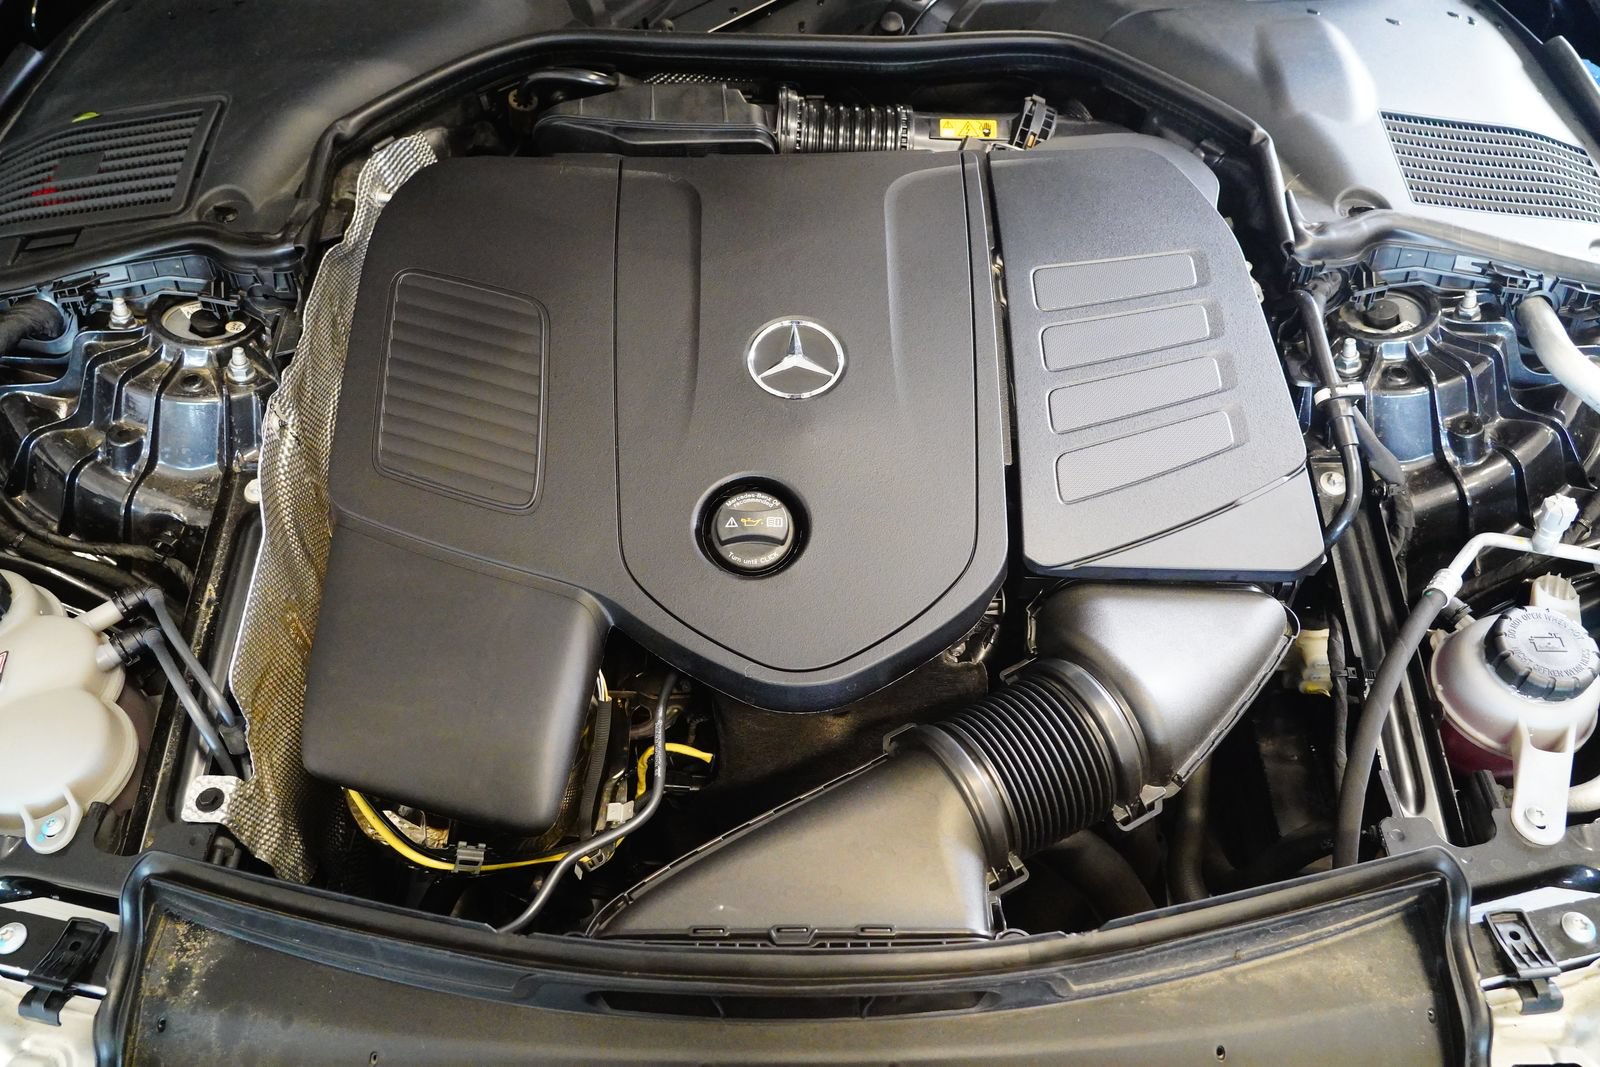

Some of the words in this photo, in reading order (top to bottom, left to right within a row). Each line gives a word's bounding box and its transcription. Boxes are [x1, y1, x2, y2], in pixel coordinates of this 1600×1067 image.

[725, 493, 772, 507] Mercedes-Benz
[733, 498, 774, 508] recommended
[728, 551, 742, 563] Turn
[760, 551, 779, 564] CLICK
[1521, 612, 1543, 621] OPEN
